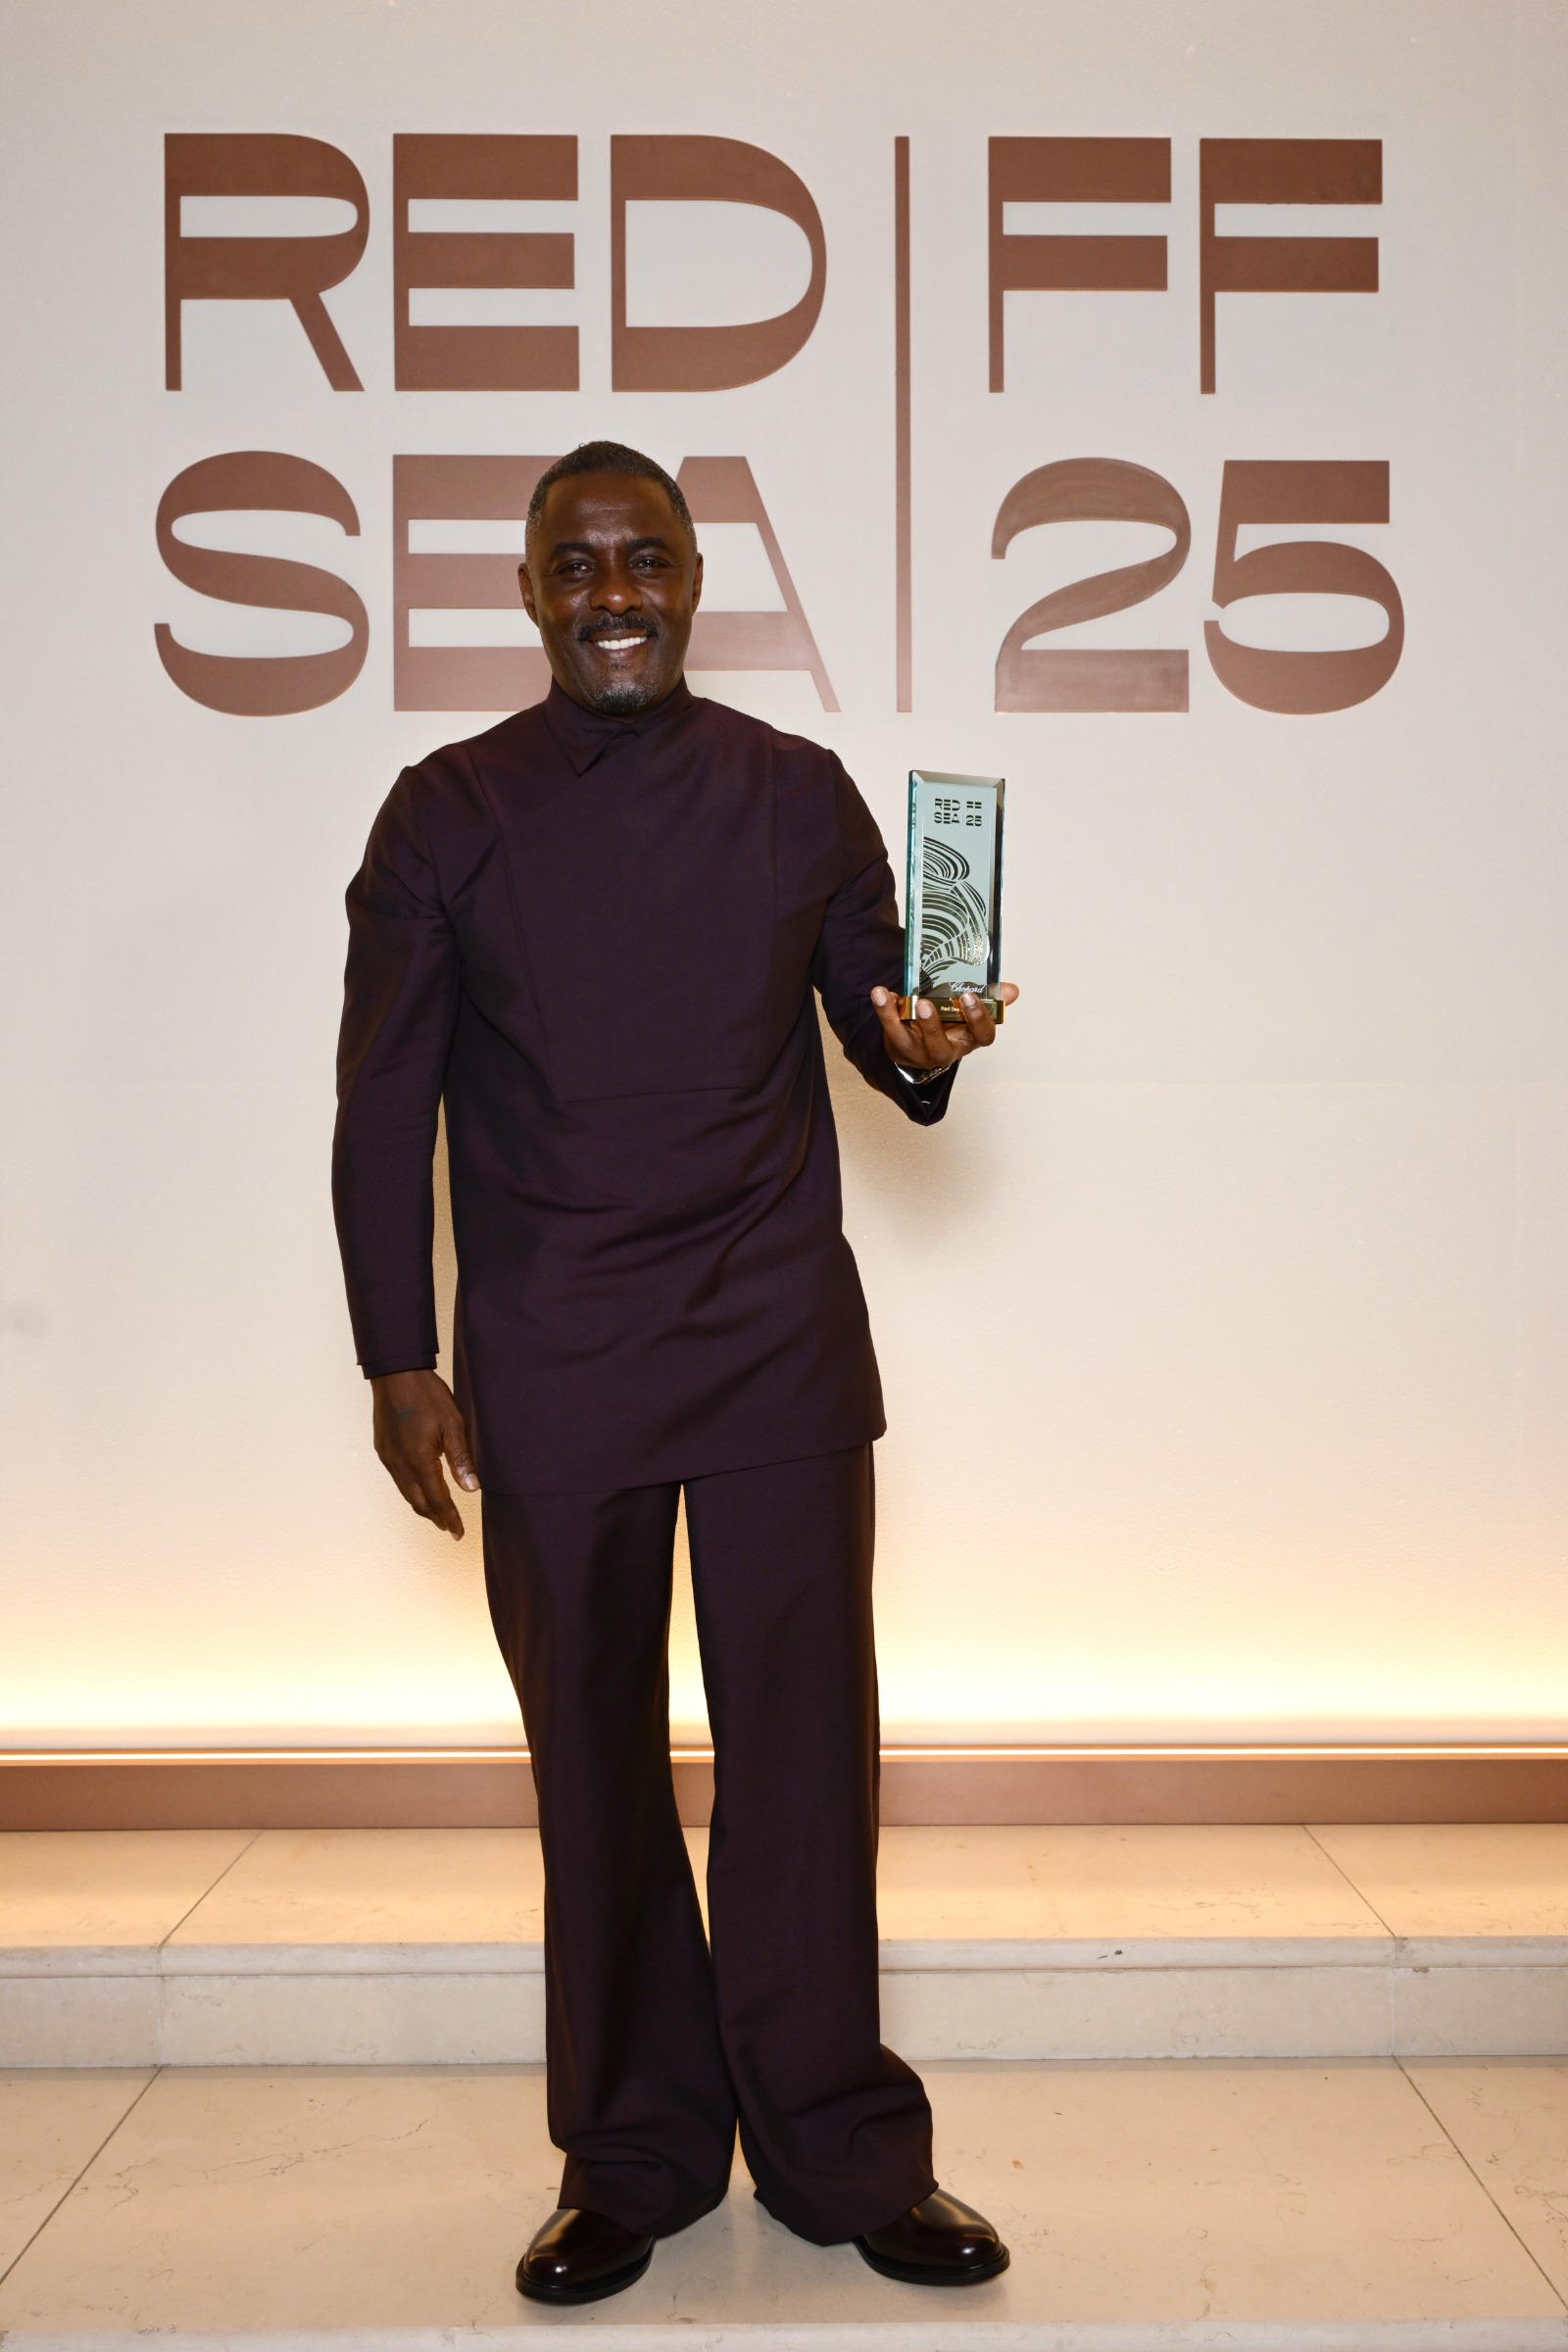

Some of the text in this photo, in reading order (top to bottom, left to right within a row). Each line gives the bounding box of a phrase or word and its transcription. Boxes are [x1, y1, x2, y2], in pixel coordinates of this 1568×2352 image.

[163, 132, 1384, 396] RED FF
[154, 451, 1404, 718] SEA 25
[935, 799, 982, 812] RED FF
[934, 812, 982, 826] SEA 25
[949, 981, 986, 994] Chopard
